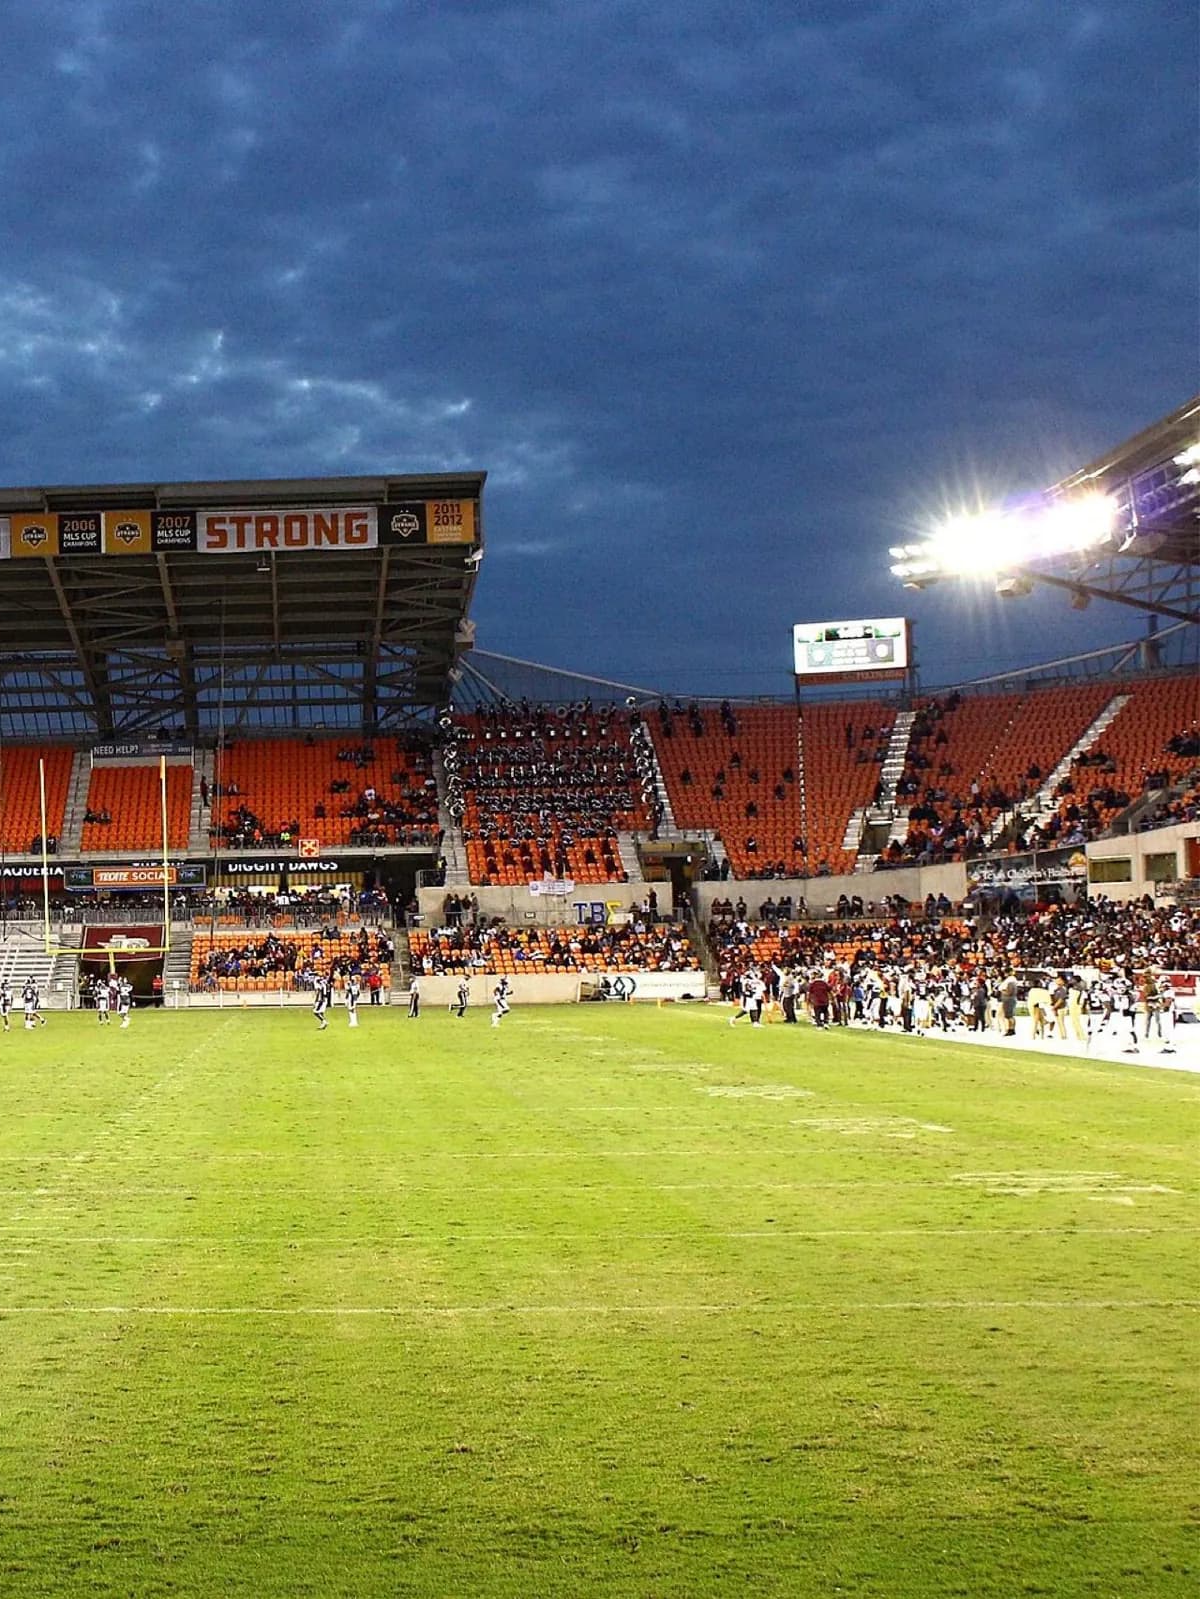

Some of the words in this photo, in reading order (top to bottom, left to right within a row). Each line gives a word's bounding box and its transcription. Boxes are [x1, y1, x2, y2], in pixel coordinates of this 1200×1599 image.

[434, 504, 461, 514] 2011
[157, 516, 191, 528] 2007
[434, 515, 463, 525] 2012
[64, 520, 96, 531] 2006
[206, 512, 368, 549] STRONG
[64, 532, 79, 540] MLS
[81, 532, 97, 540] CUP
[157, 529, 173, 537] MLS
[174, 529, 191, 537] CUP
[93, 746, 114, 755] NEED
[289, 861, 338, 871] DAWGS
